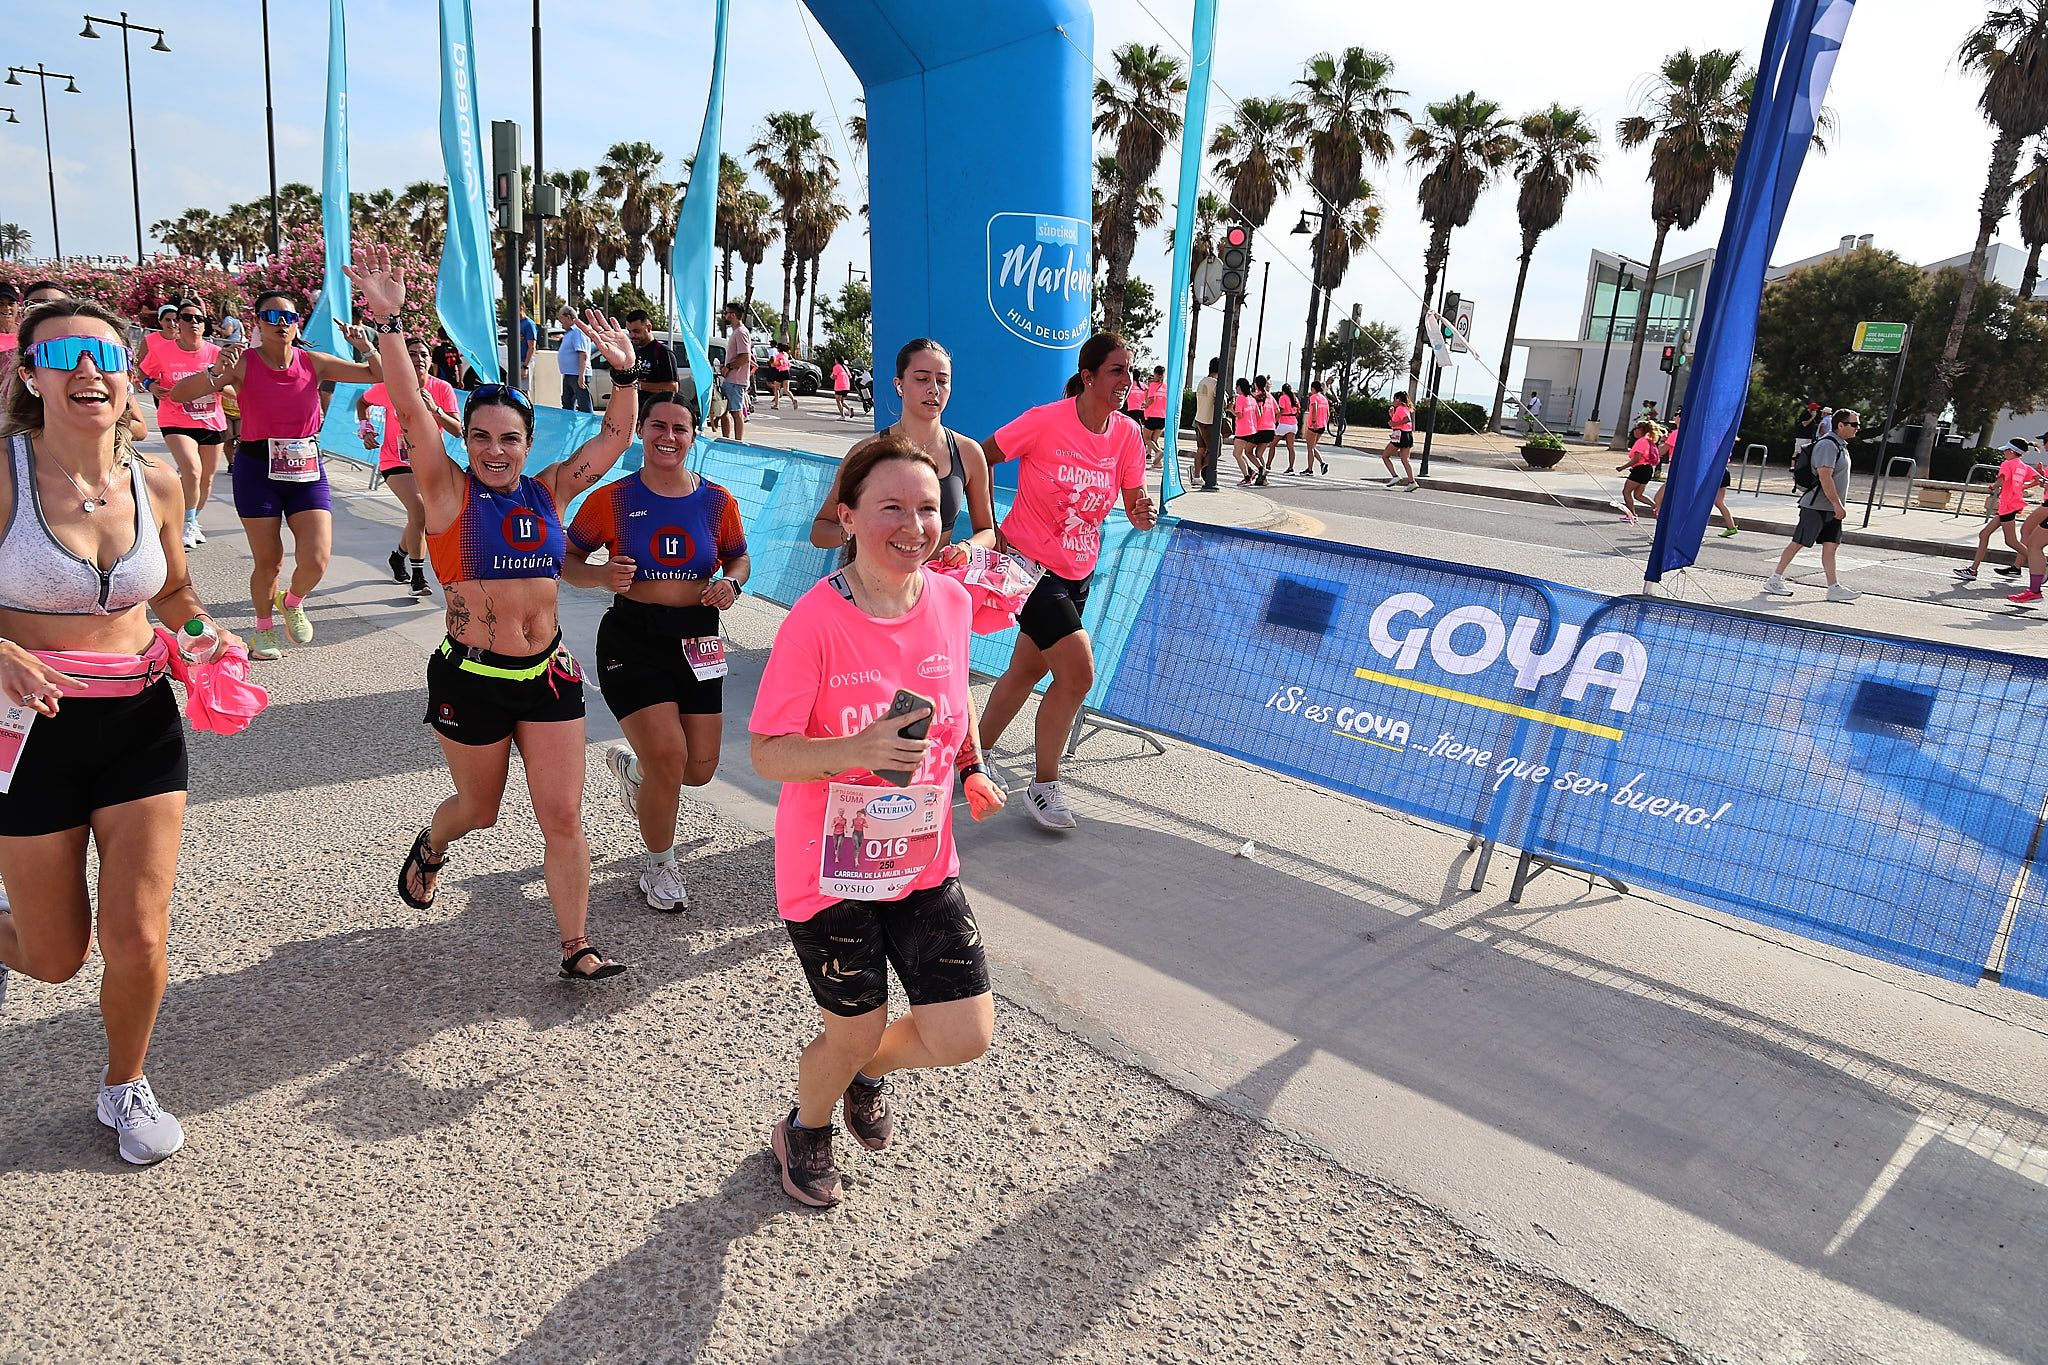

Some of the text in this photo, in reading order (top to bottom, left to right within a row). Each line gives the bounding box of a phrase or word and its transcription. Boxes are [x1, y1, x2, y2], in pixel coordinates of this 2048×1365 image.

[1007, 308, 1031, 332] HIJA
[1035, 325, 1050, 339] DE
[1052, 329, 1070, 340] LOS
[288, 459, 306, 467] 016
[493, 554, 553, 569] Litotúria
[700, 640, 719, 654] 016
[1368, 592, 1649, 714] GOYA
[829, 669, 881, 689] OYSHO
[1304, 704, 1334, 723] es
[1336, 706, 1411, 745] GOYA
[1492, 756, 1551, 792] que
[1553, 771, 1608, 797] ser
[1610, 771, 1733, 830] bueno!
[839, 794, 864, 804] SUMA
[869, 804, 913, 814] ASTURIANA
[865, 837, 909, 859] 016
[879, 861, 895, 870] 250
[834, 870, 863, 879] CARRERA
[834, 883, 875, 894] OYSHO
